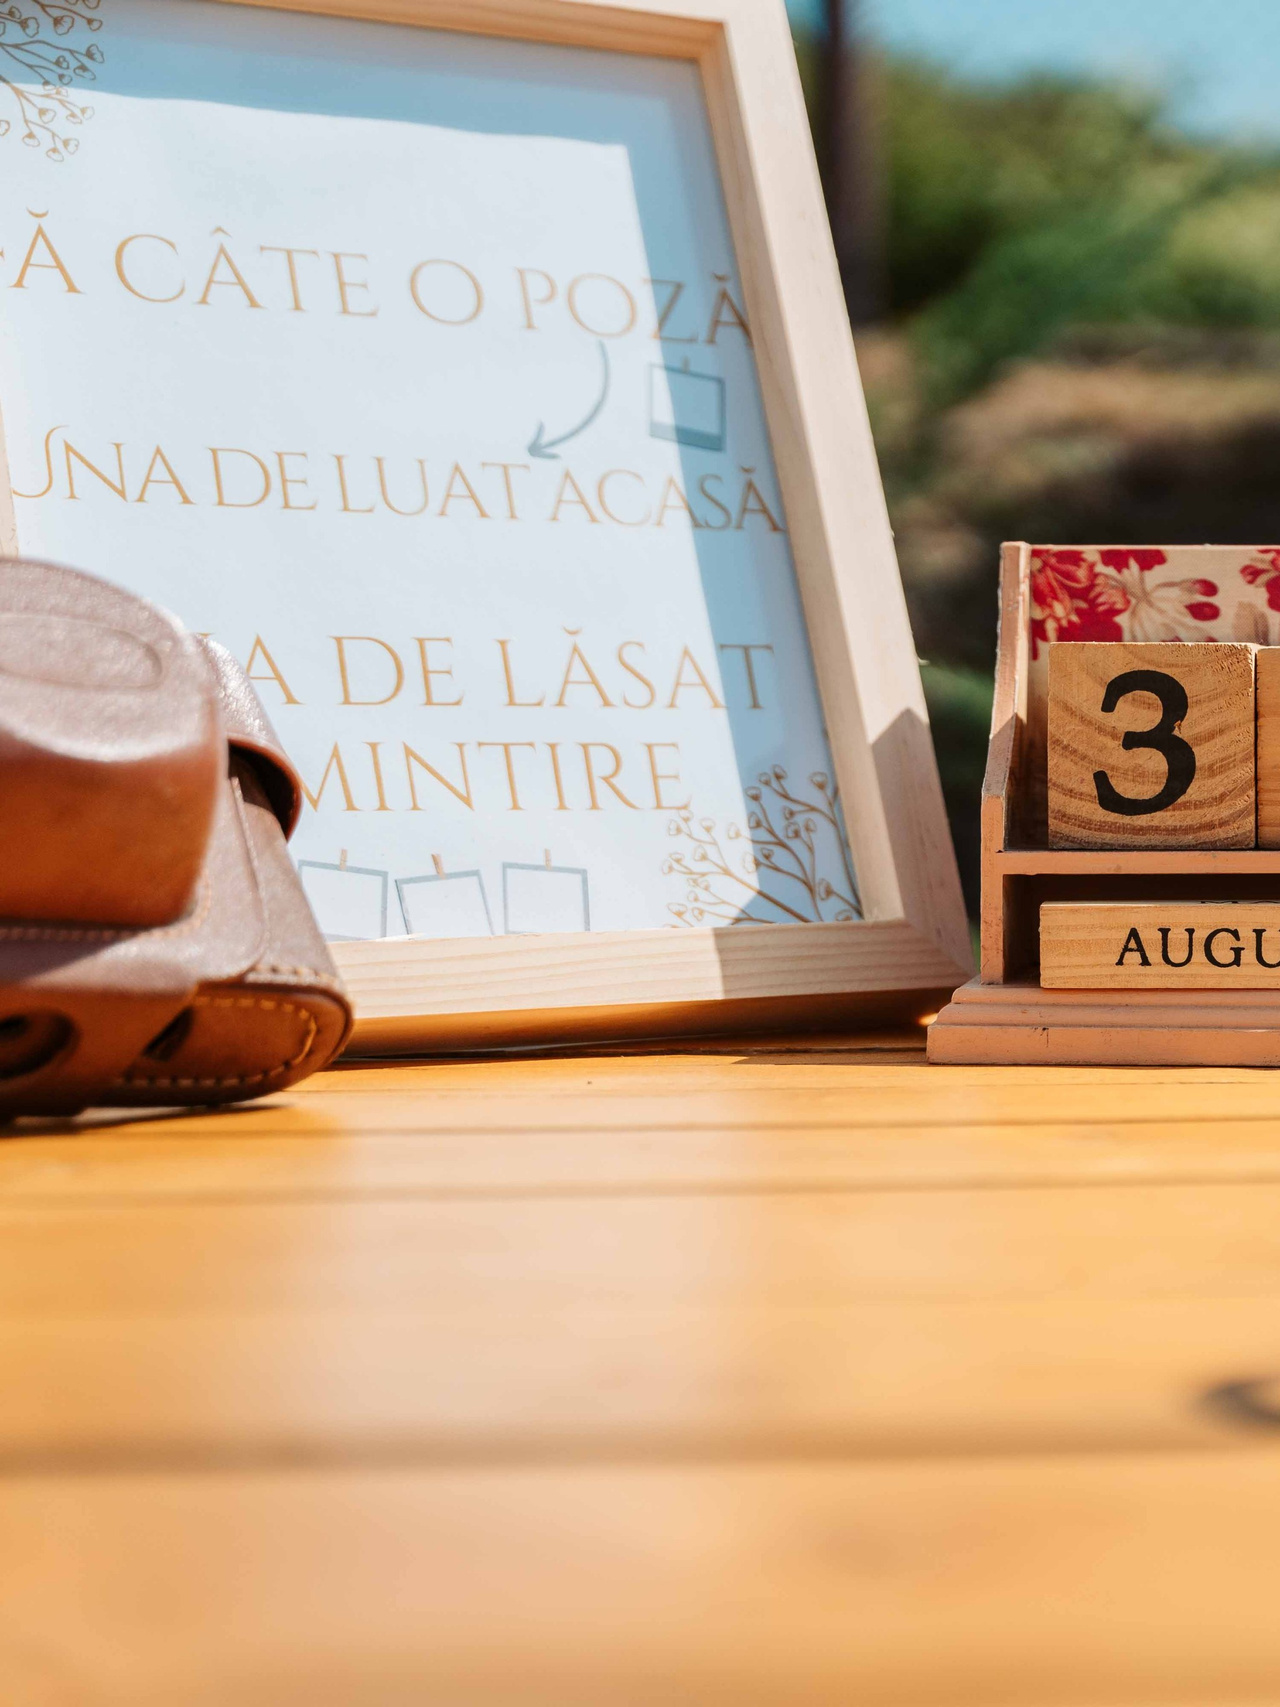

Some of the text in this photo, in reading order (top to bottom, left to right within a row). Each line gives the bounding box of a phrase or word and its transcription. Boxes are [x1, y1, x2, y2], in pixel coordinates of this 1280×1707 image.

[115, 226, 380, 318] CÂTE
[409, 259, 484, 326] O
[514, 267, 754, 348] POZĂ
[207, 447, 318, 510] DE
[332, 454, 531, 521] LUAT
[548, 465, 786, 533] ACASĂ
[326, 636, 465, 706] DE
[494, 624, 775, 710] LĂSAT
